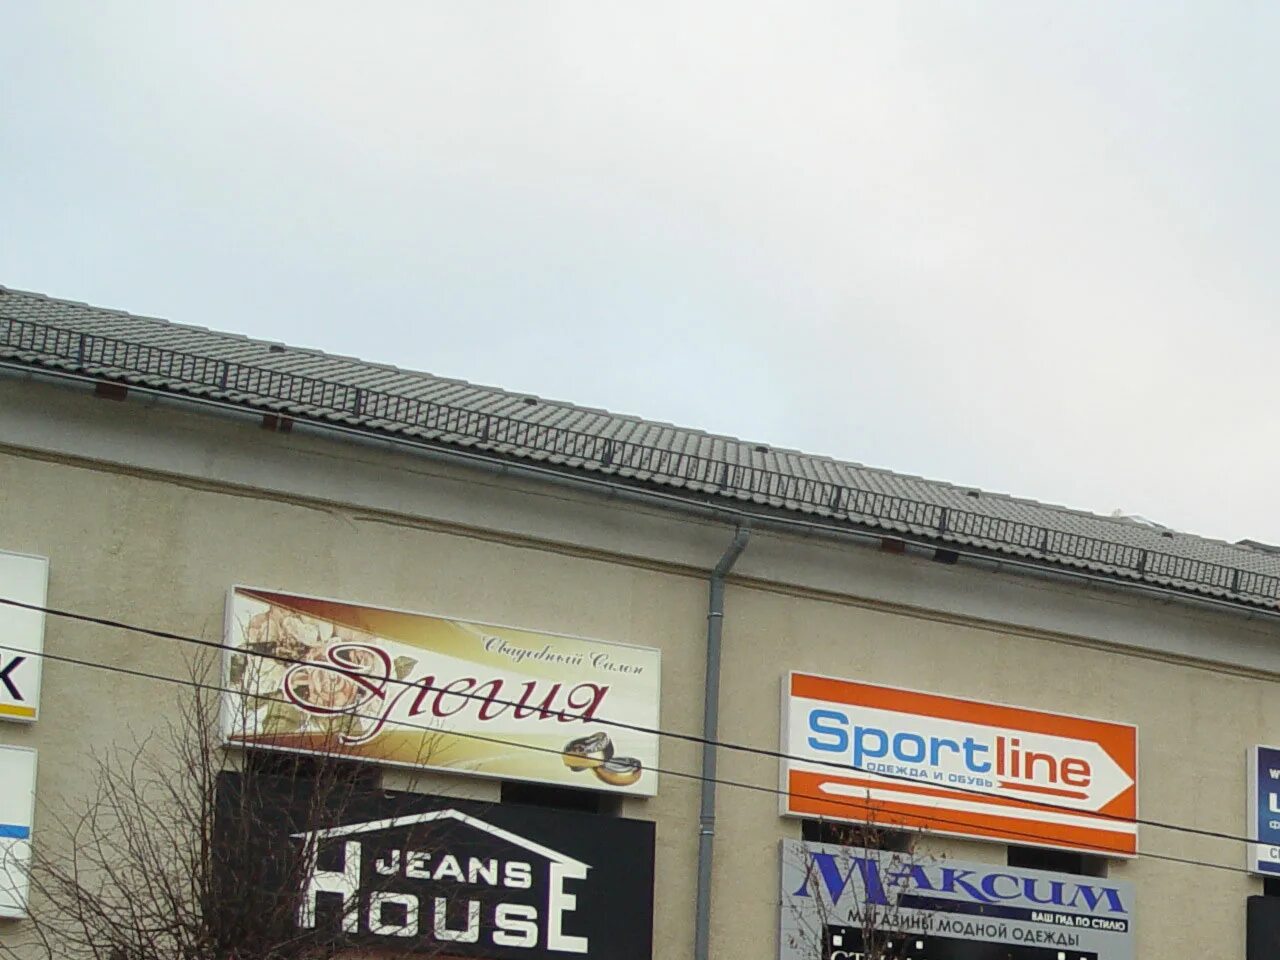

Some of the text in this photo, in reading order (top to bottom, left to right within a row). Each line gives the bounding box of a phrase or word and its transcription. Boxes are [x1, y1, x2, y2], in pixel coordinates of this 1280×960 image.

[284, 641, 610, 745] Элегия
[807, 708, 1092, 788] Sportline
[866, 762, 993, 788] ОДЕЖДА И ОБУВЬ
[375, 849, 532, 890] JEANS
[936, 919, 1008, 939] МОДНОЙ
[1012, 927, 1080, 947] ОДЕЖДЫ
[1075, 917, 1090, 928] ПО
